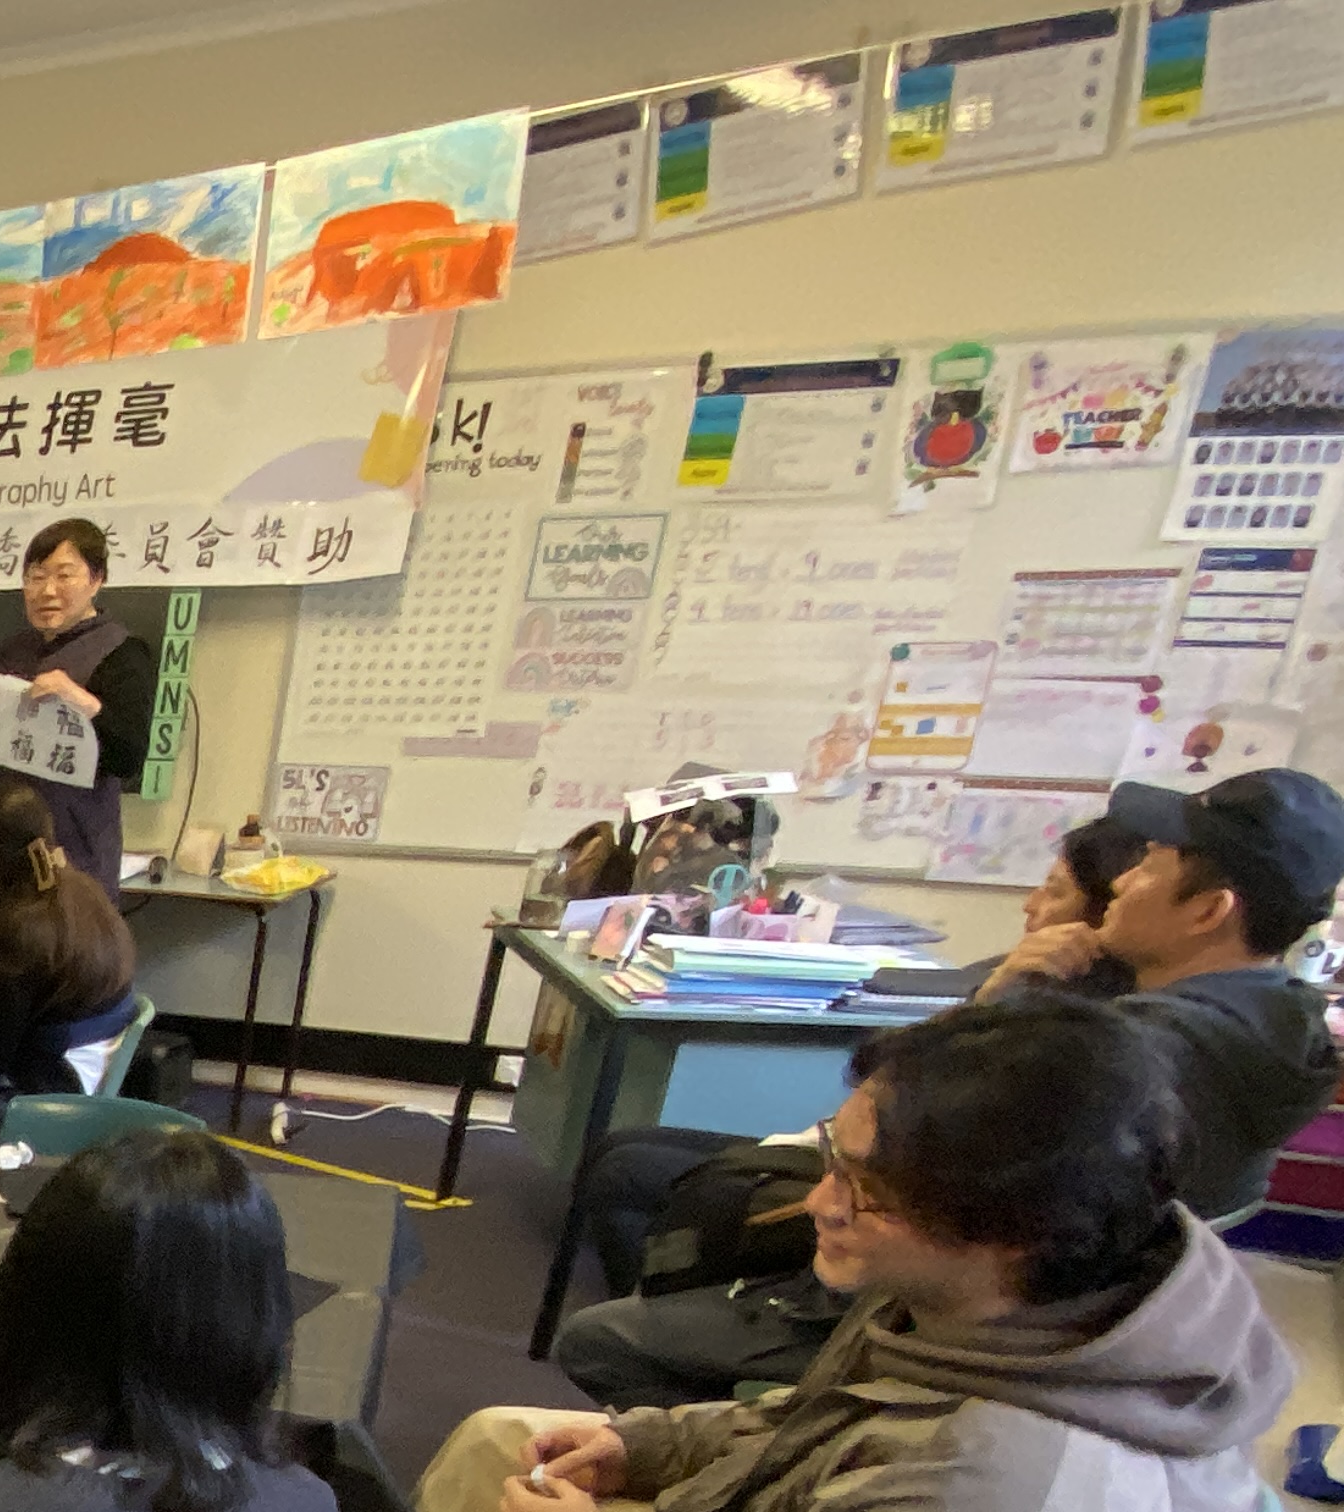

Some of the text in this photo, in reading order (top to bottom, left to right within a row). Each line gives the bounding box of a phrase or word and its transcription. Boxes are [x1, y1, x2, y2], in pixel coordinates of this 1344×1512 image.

[489, 446, 543, 472] today
[75, 471, 117, 501] Art
[542, 542, 650, 564] LEARNING
